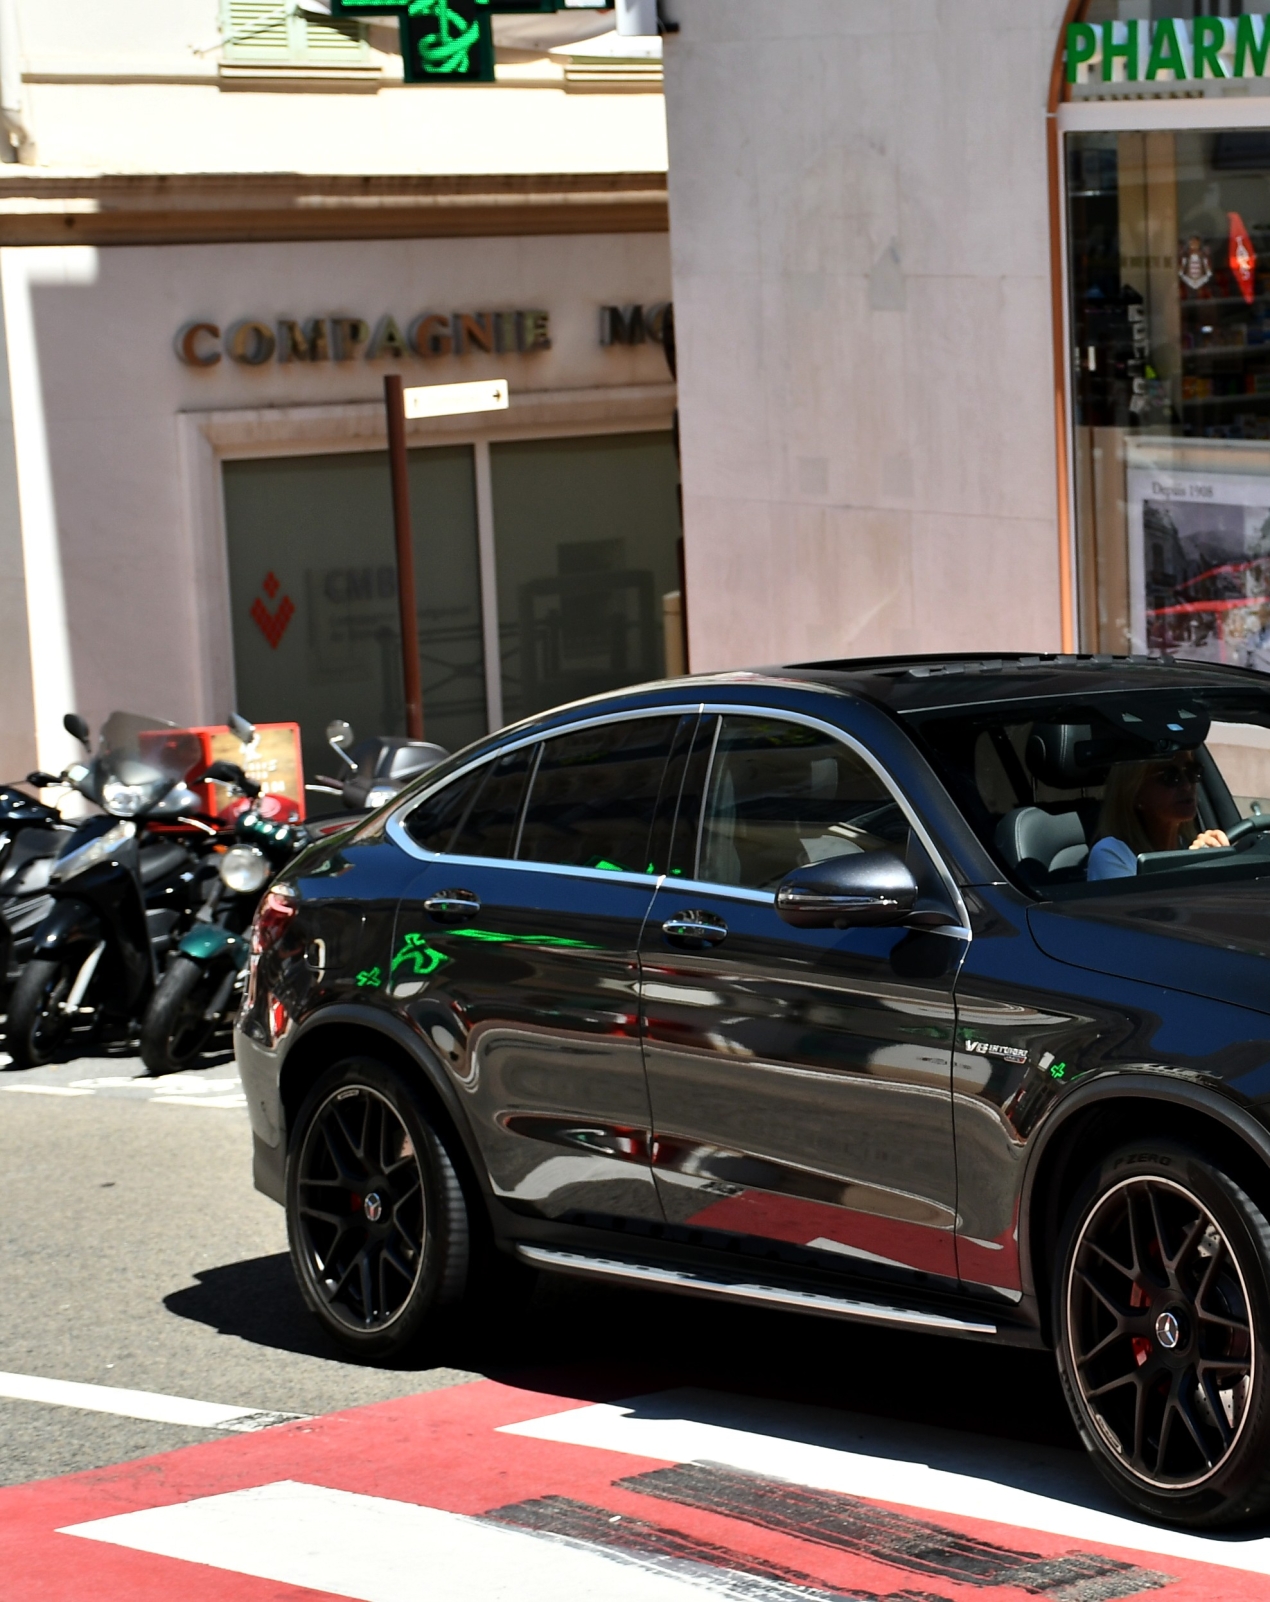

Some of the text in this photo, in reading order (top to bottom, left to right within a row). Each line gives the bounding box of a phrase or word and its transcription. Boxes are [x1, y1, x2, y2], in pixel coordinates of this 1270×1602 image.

[176, 309, 552, 367] COMPAGNIE
[1152, 481, 1186, 500] Depuis
[965, 1040, 989, 1054] V8
